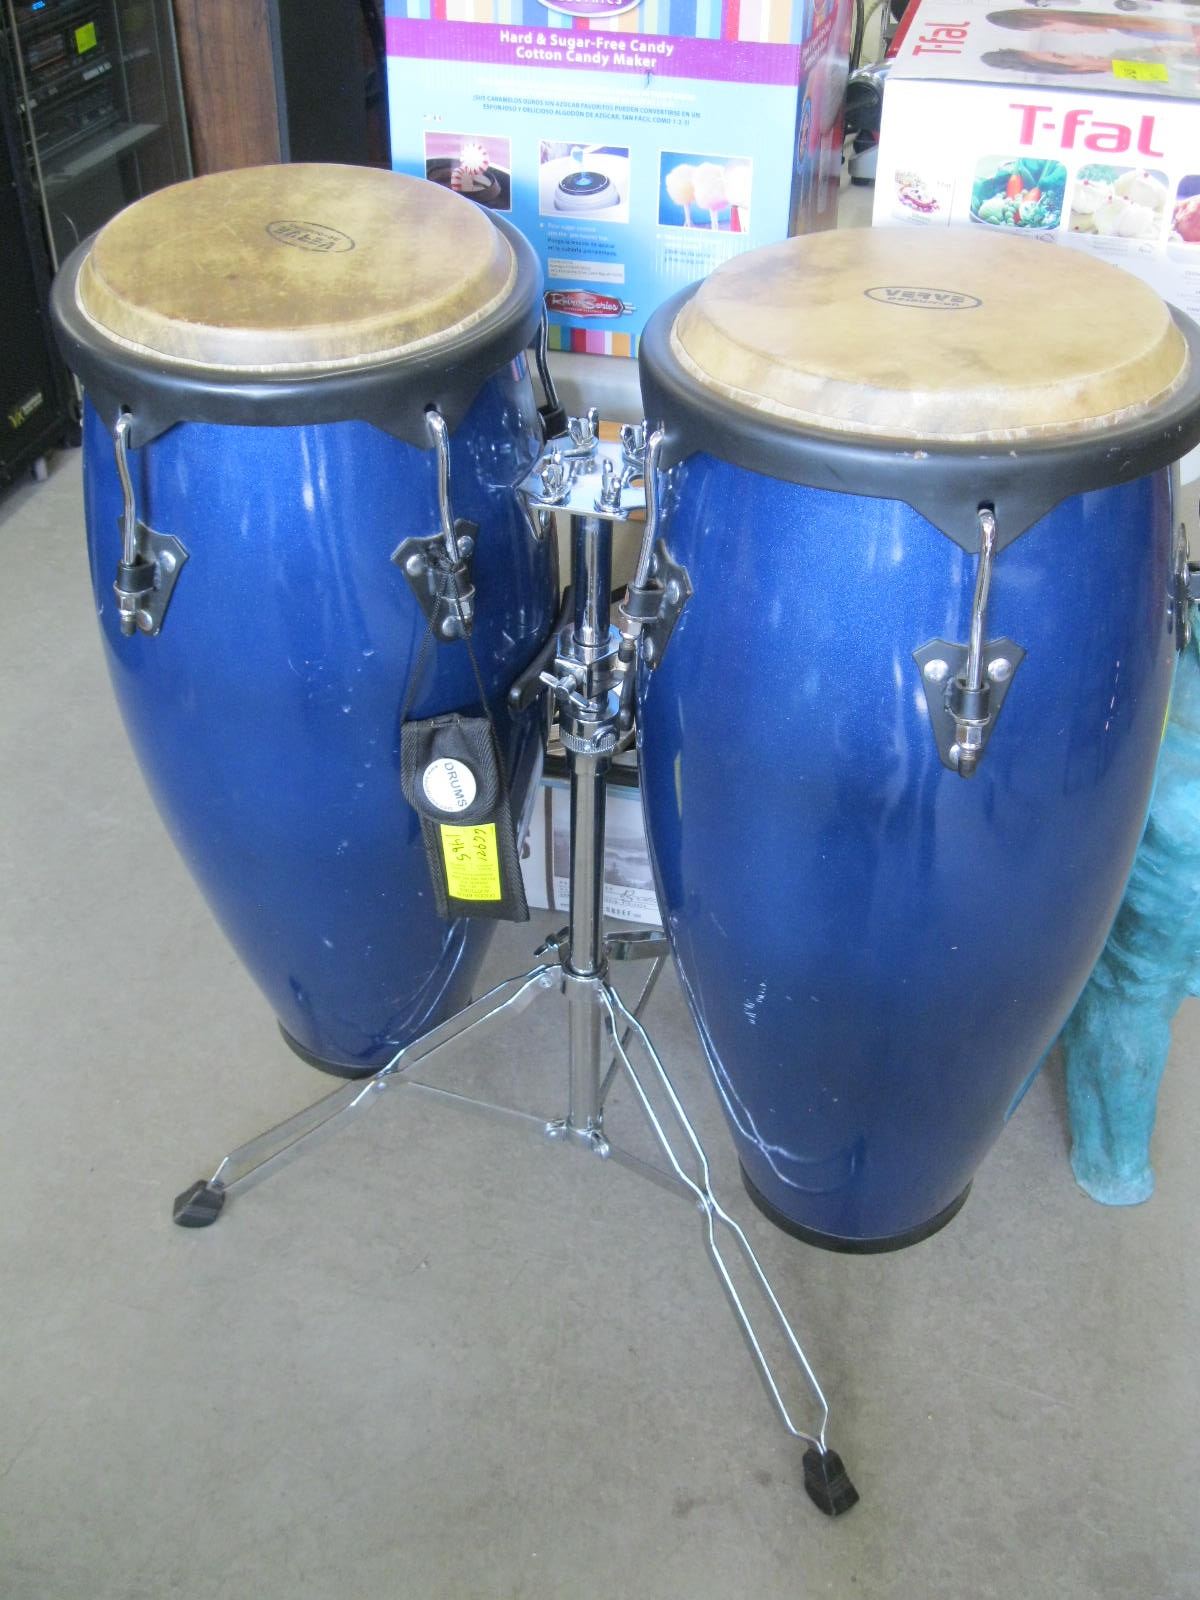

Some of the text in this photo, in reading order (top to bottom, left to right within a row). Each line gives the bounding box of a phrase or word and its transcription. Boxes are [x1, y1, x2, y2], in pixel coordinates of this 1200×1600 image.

[500, 30, 674, 57] Hard & Sugar-Free Candy
[911, 20, 970, 56] T-fal
[516, 46, 657, 68] Cotton Candy Maker
[1009, 103, 1164, 158] T-fal
[885, 289, 965, 303] VERVE
[443, 762, 468, 807] DRUMS
